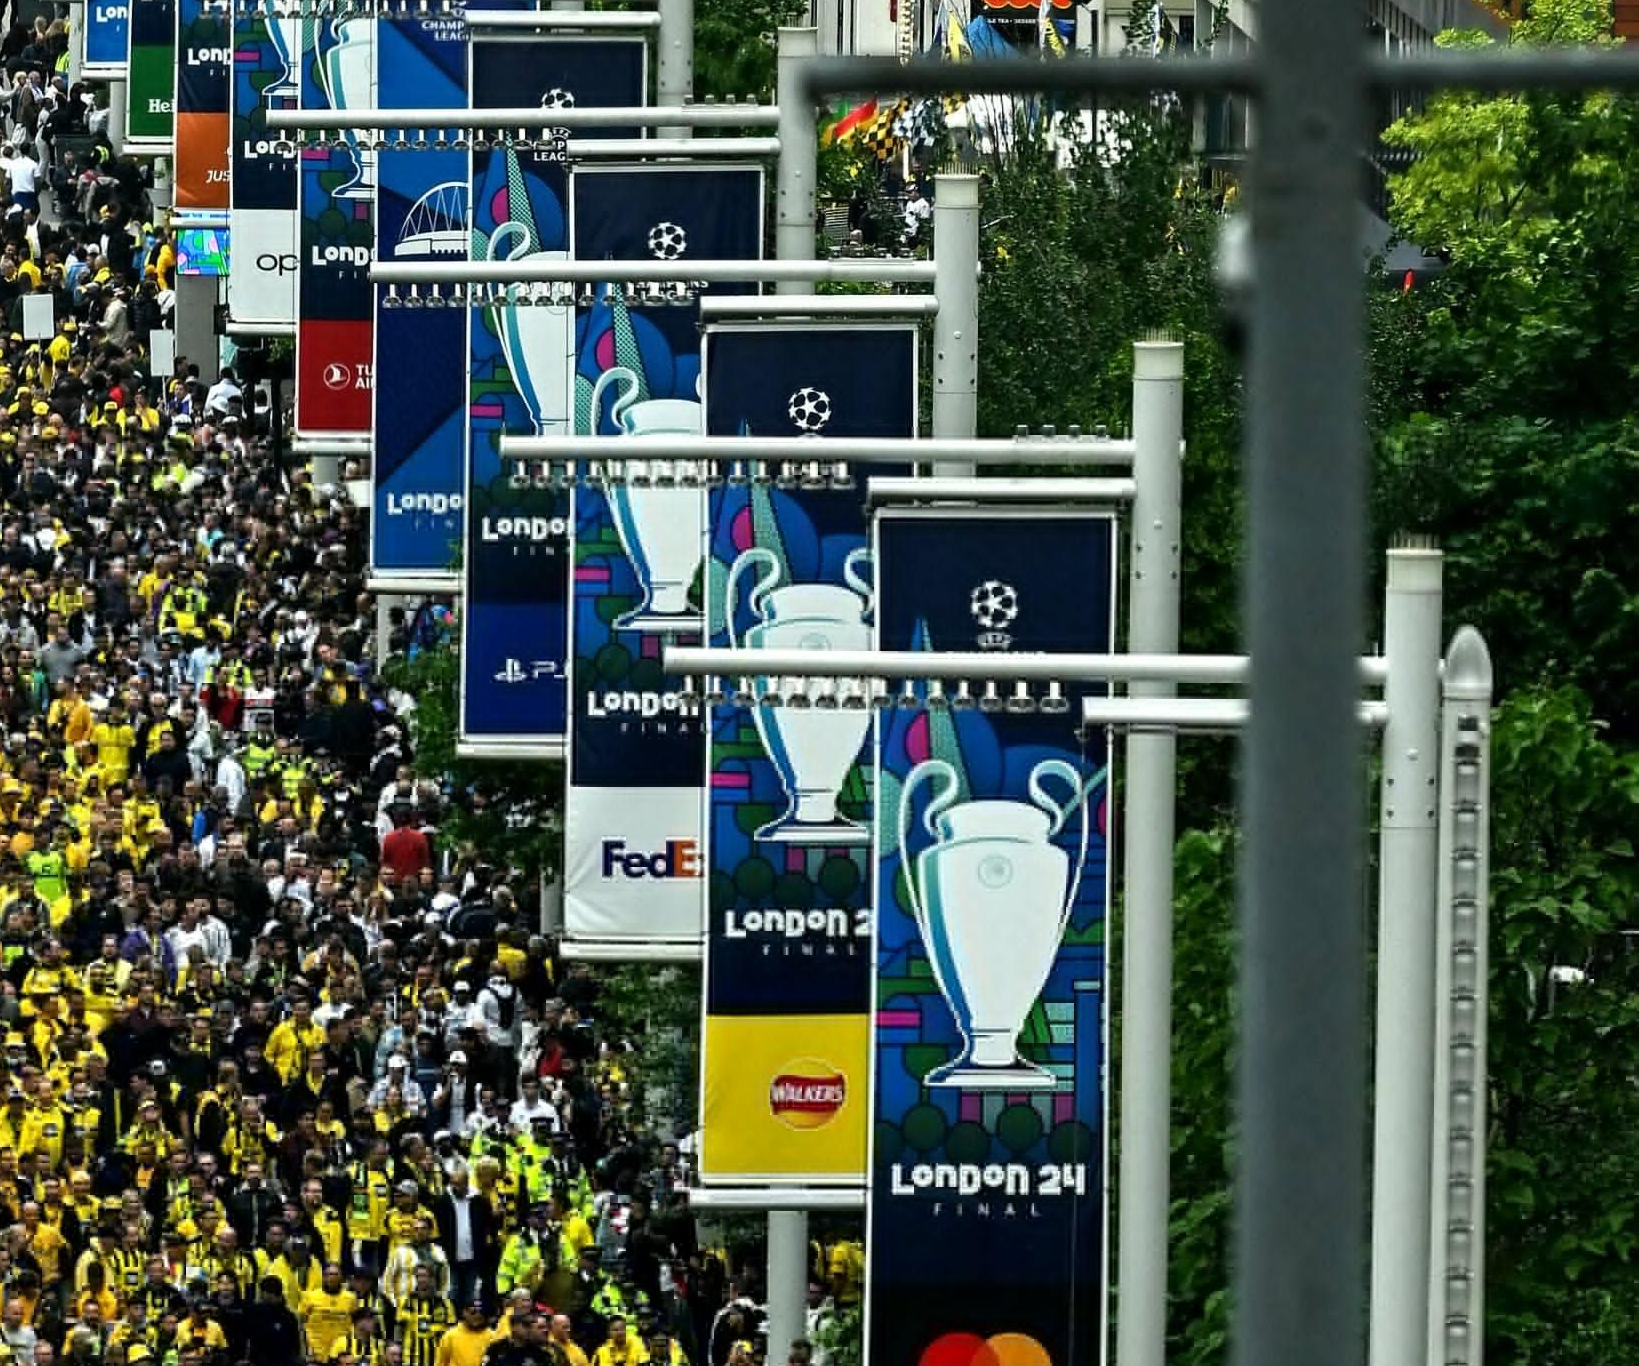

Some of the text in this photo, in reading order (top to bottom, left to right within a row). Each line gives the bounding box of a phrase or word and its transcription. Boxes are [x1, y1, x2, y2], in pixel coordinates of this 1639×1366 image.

[421, 21, 464, 30] CHAMP
[434, 32, 468, 41] LEAG
[533, 151, 566, 162] LEAG
[205, 170, 231, 184] JUS
[256, 253, 298, 276] op
[853, 908, 874, 937] 2
[1038, 1162, 1086, 1196] 24
[932, 1202, 1043, 1217] FINAL
